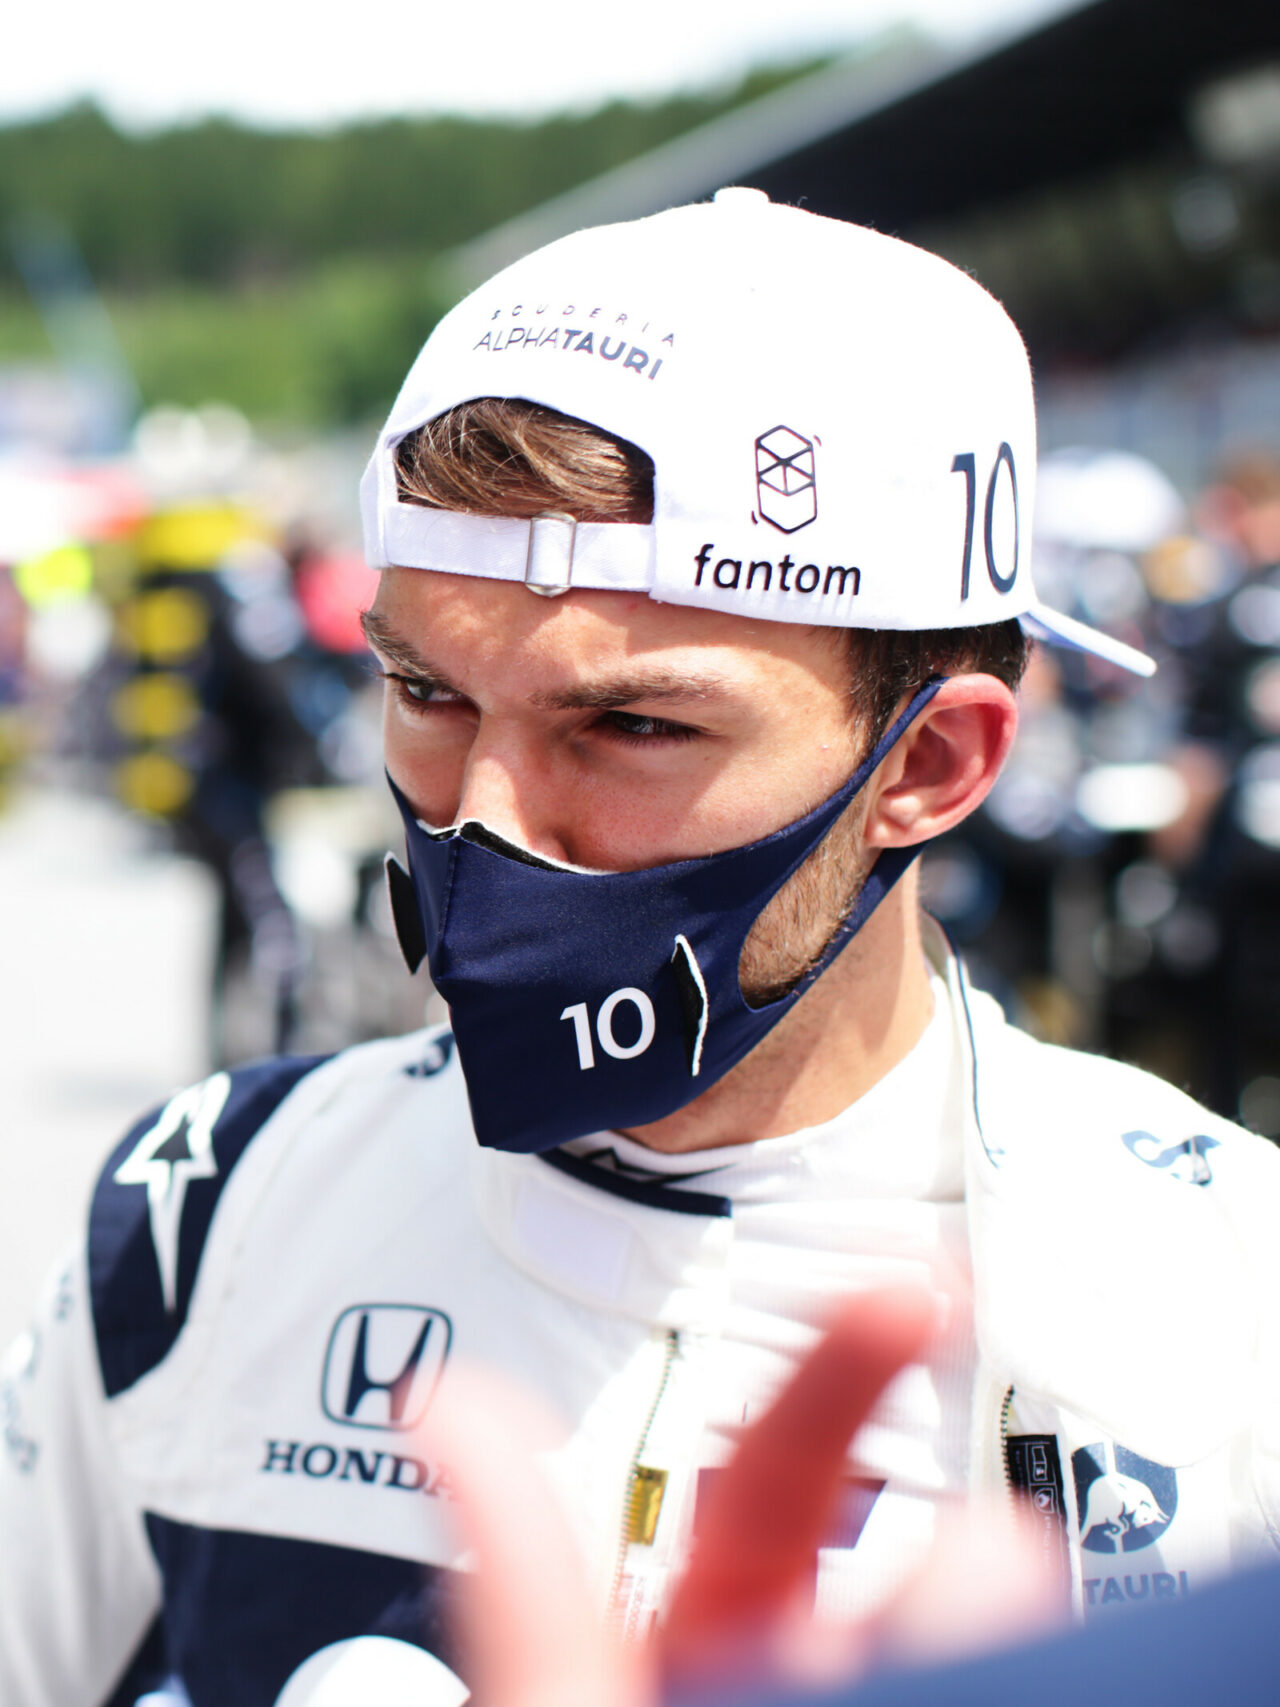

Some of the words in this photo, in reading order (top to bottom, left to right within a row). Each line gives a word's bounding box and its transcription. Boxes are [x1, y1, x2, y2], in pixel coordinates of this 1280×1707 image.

[491, 305, 674, 347] SCUDERIA
[473, 327, 663, 380] ALPHATAURI
[950, 441, 1019, 602] 10
[694, 544, 861, 595] fantom
[560, 987, 656, 1071] 10
